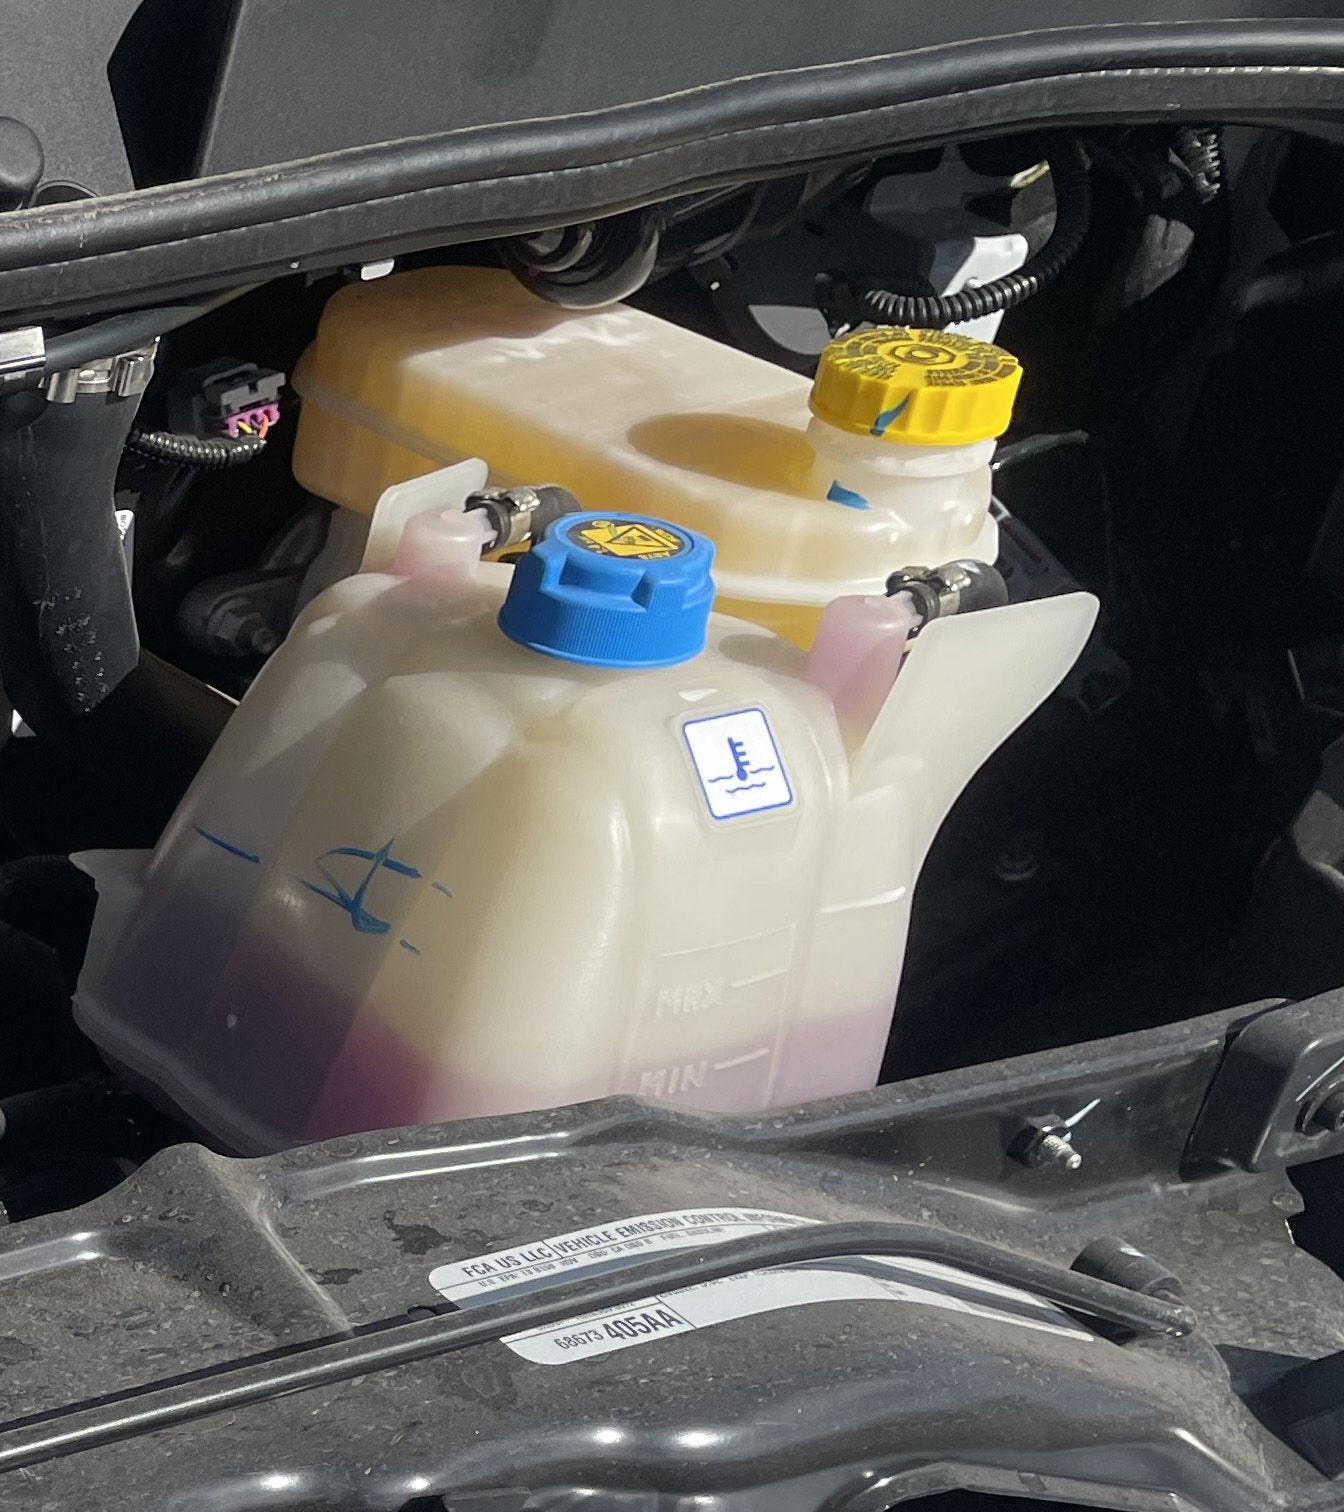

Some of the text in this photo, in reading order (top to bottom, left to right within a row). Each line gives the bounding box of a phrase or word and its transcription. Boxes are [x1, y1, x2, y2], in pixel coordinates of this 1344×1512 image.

[639, 1060, 709, 1098] MIN
[461, 1262, 497, 1277] FCA
[494, 1255, 522, 1268] US
[519, 1247, 552, 1262] LLC
[553, 1230, 618, 1253] VEHICLE
[615, 1217, 685, 1238] EMISSION
[683, 1212, 744, 1225] CONTROL
[553, 1330, 604, 1350] 68673
[602, 1309, 683, 1340] 405AA
